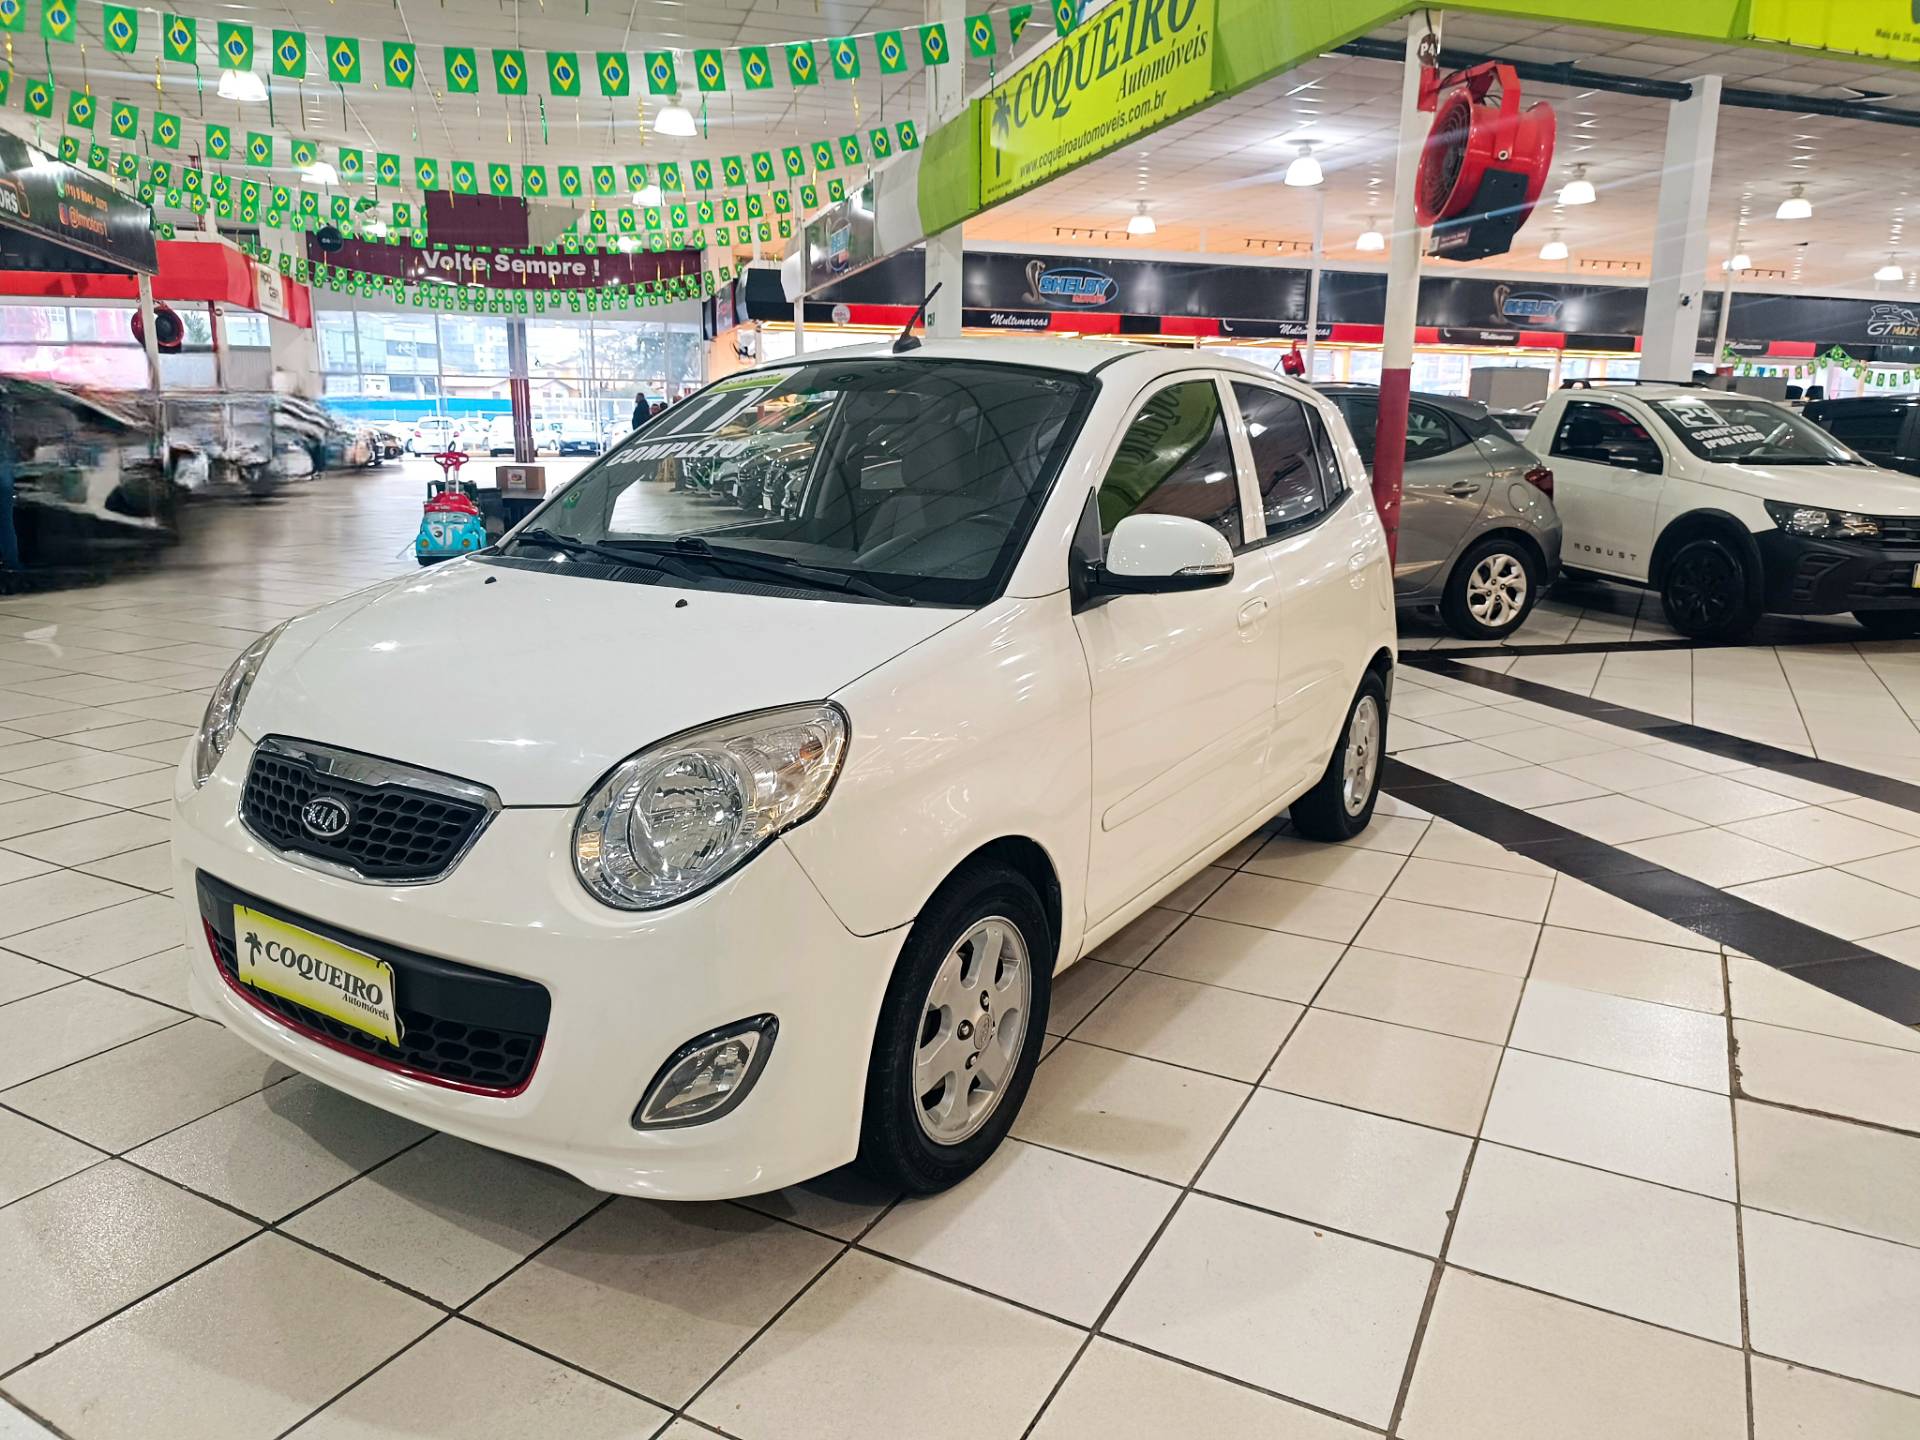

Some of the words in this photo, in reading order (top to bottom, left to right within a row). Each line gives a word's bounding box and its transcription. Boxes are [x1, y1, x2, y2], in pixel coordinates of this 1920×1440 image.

[1117, 25, 1208, 102] Automóveis
[1020, 89, 1167, 178] www.coqueiroautomoveis.com.br
[422, 250, 487, 271] Volte
[494, 253, 586, 279] Sempre
[593, 259, 600, 276] !
[1039, 275, 1113, 296] SHELBY
[990, 313, 1049, 327] Multimarcas
[1867, 322, 1900, 336] GT
[666, 387, 764, 436] 11
[1675, 407, 1716, 427] 24
[1691, 424, 1757, 441] COMPLETO
[1702, 436, 1733, 450] IPVA
[1733, 432, 1766, 444] PAGO
[605, 440, 744, 468] COMPLETO
[1573, 542, 1638, 561] ROBUST
[304, 802, 340, 832] KIA
[265, 940, 384, 1006] COQUEIRO
[342, 992, 390, 1022] Automóveis
